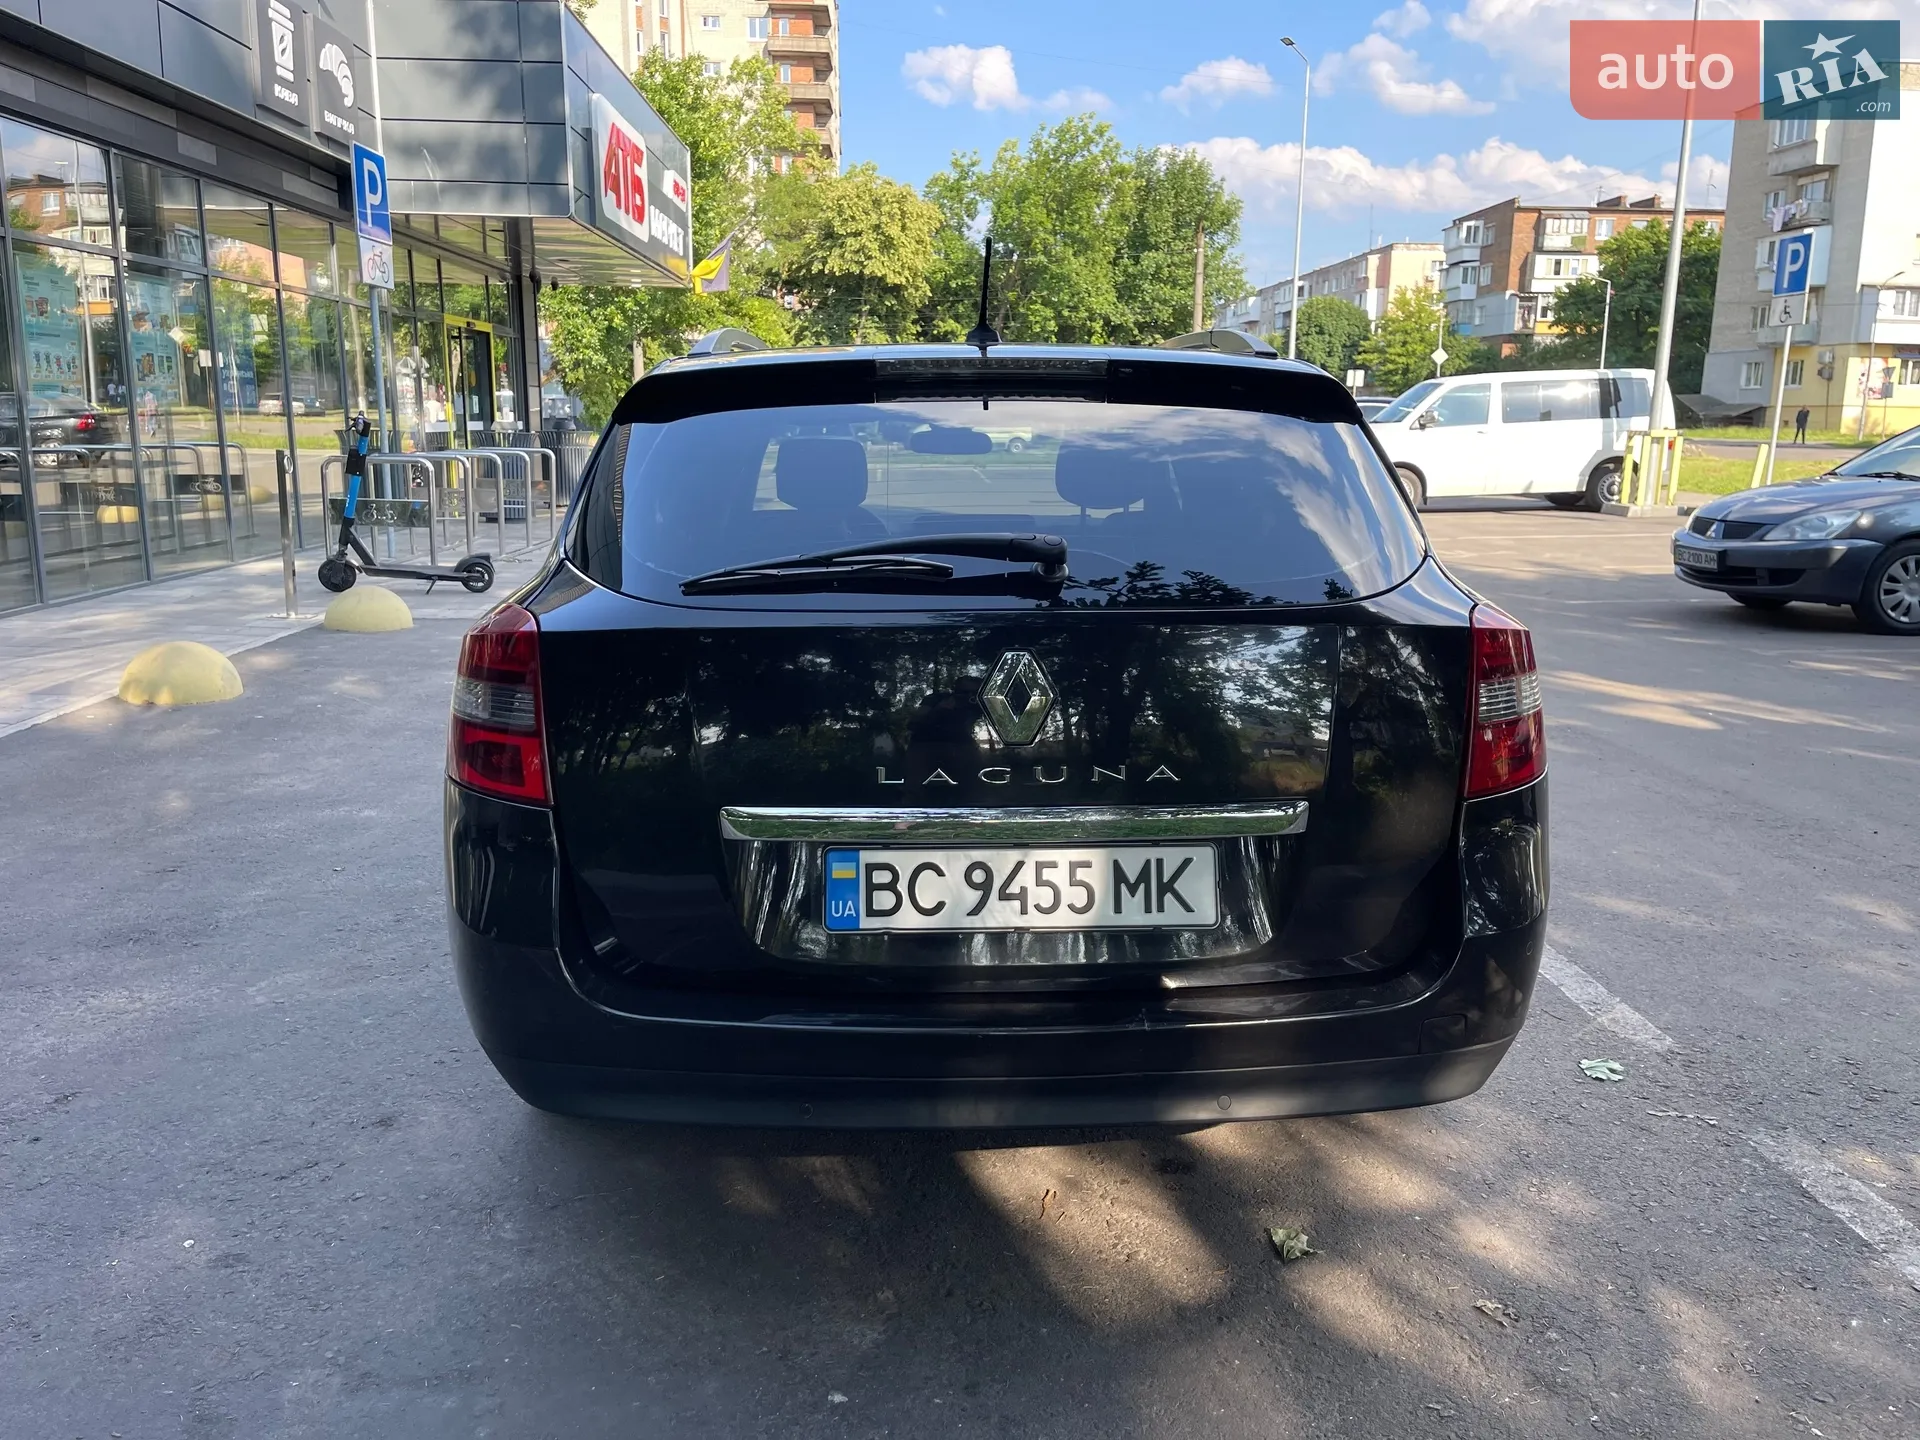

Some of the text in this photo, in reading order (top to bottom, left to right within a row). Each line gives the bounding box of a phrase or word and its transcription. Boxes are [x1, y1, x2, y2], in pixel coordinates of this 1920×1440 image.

[274, 83, 299, 106] КАВА
[363, 157, 383, 228] P
[603, 122, 645, 226] АТБ
[1783, 242, 1805, 288] P
[876, 764, 1182, 785] LAGUNA
[831, 901, 857, 918] UA
[865, 856, 1196, 918] BC 9455 MK
